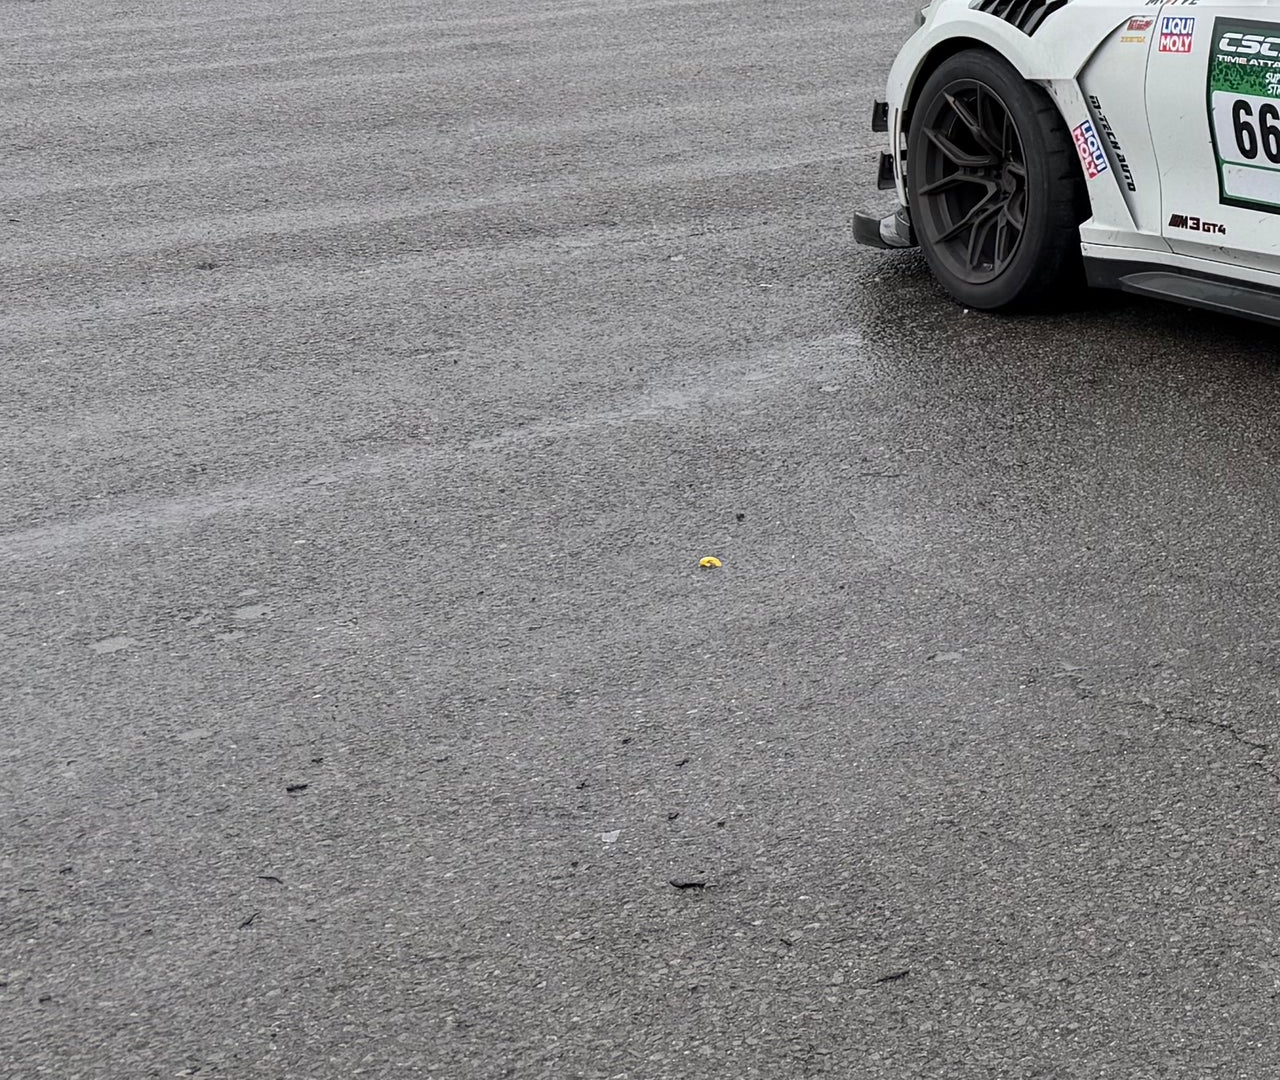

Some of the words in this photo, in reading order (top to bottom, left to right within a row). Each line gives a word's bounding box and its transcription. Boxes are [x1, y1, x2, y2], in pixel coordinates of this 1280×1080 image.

[1162, 18, 1194, 35] LIQUI
[1159, 35, 1192, 51] MOLY
[1216, 54, 1247, 65] TIME
[1073, 127, 1098, 177] MOLY
[1081, 121, 1107, 173] LIQUI
[1115, 151, 1137, 192] AUTO
[1202, 221, 1226, 235] GT4
